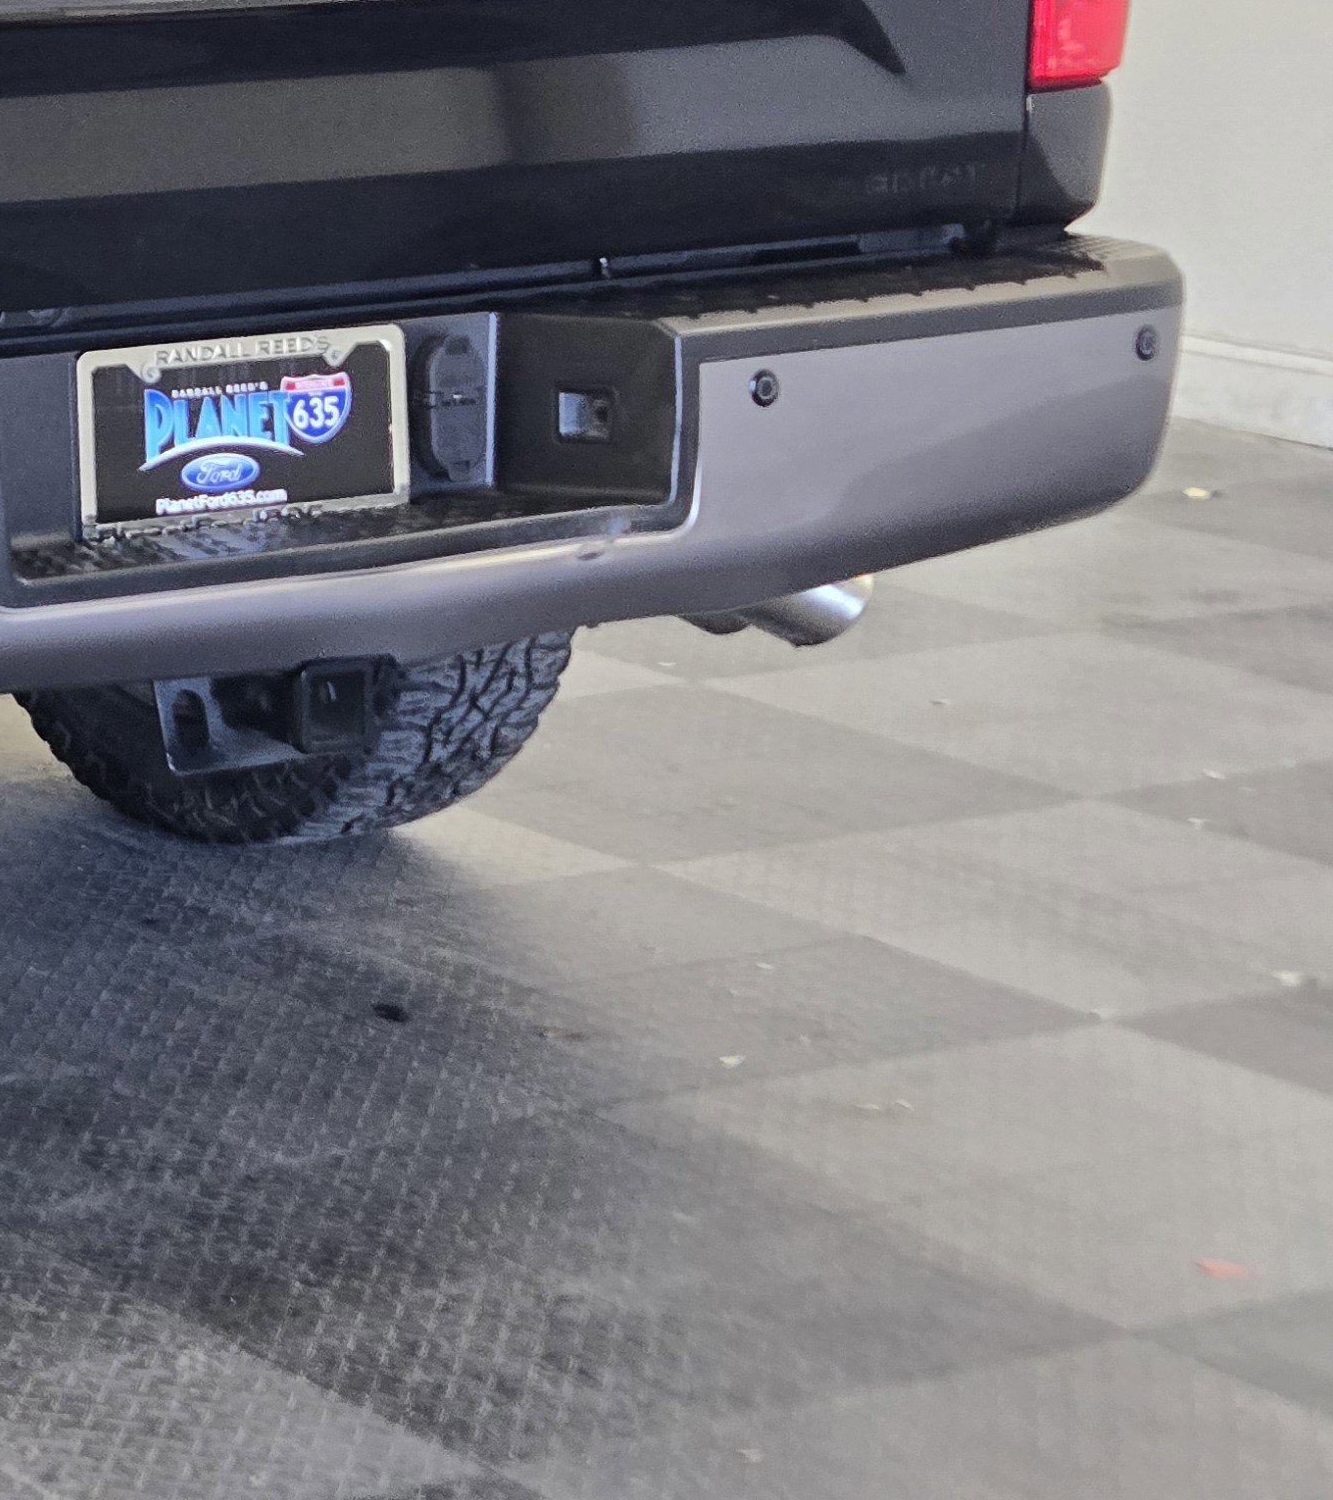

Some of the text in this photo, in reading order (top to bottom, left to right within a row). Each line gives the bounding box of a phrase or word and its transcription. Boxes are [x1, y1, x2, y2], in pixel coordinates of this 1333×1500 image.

[155, 335, 331, 366] RANDALL REED'S
[144, 387, 340, 463] PLANET 635
[196, 461, 244, 485] Ford
